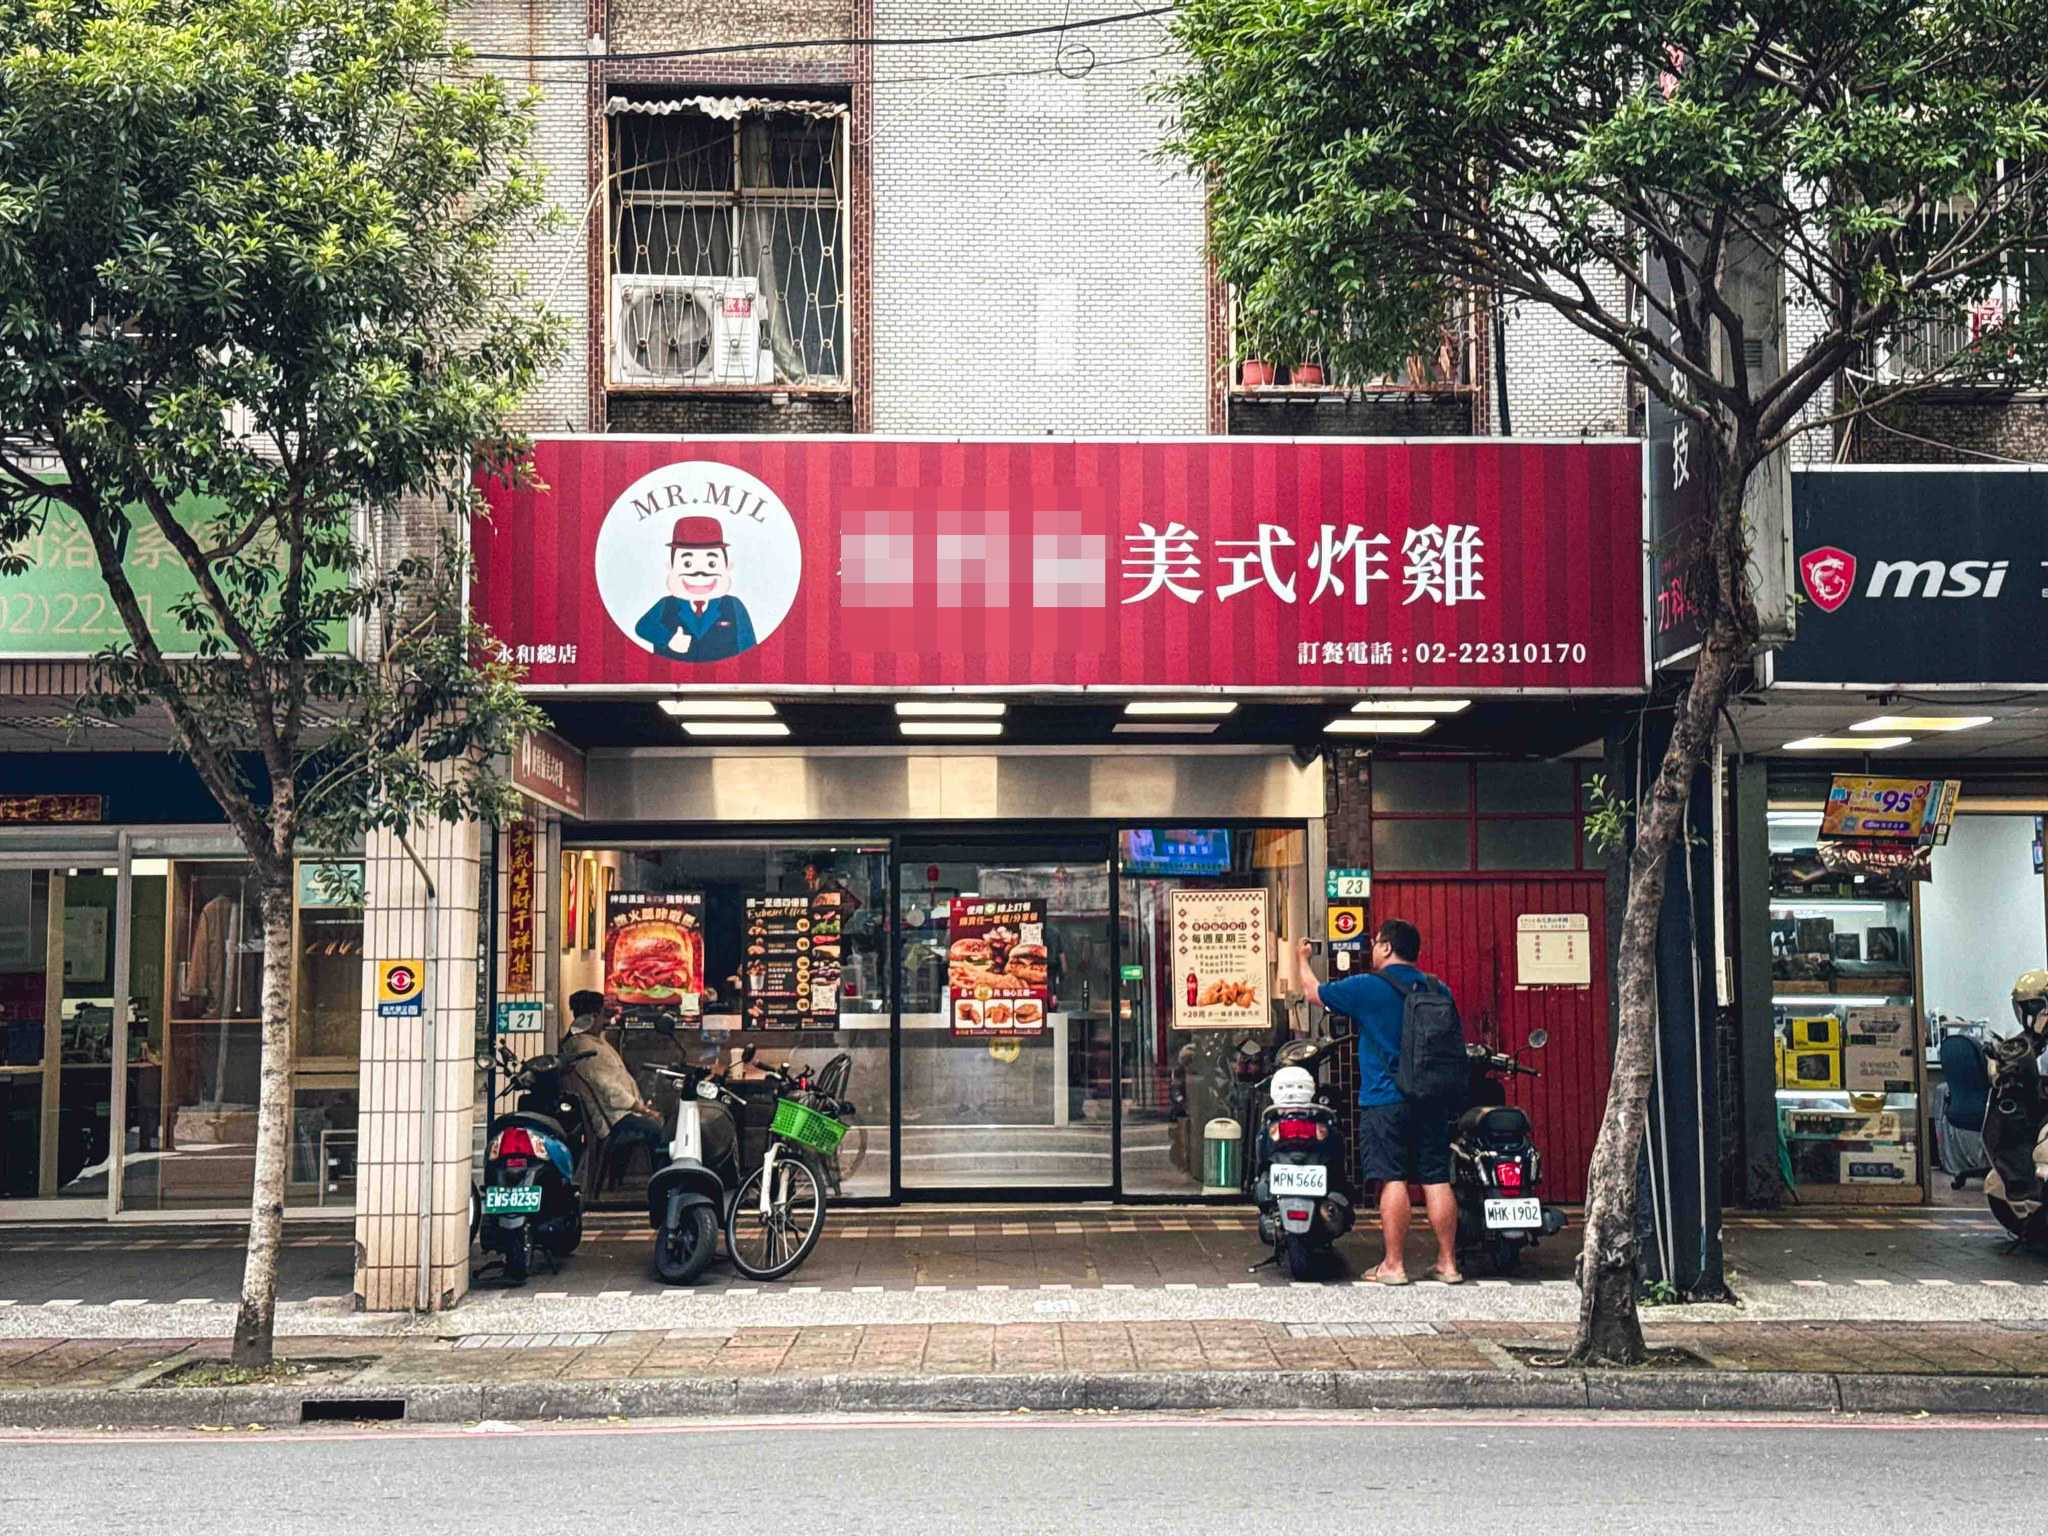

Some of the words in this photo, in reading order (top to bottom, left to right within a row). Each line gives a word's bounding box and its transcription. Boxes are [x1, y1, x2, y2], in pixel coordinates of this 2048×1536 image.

[1120, 521, 1487, 607] 美式炸雞
[1865, 560, 2009, 598] msi
[495, 643, 578, 665] 永和總店
[1345, 879, 1363, 894] 23
[1192, 933, 1247, 943] 每週星期三
[516, 1012, 534, 1028] 21
